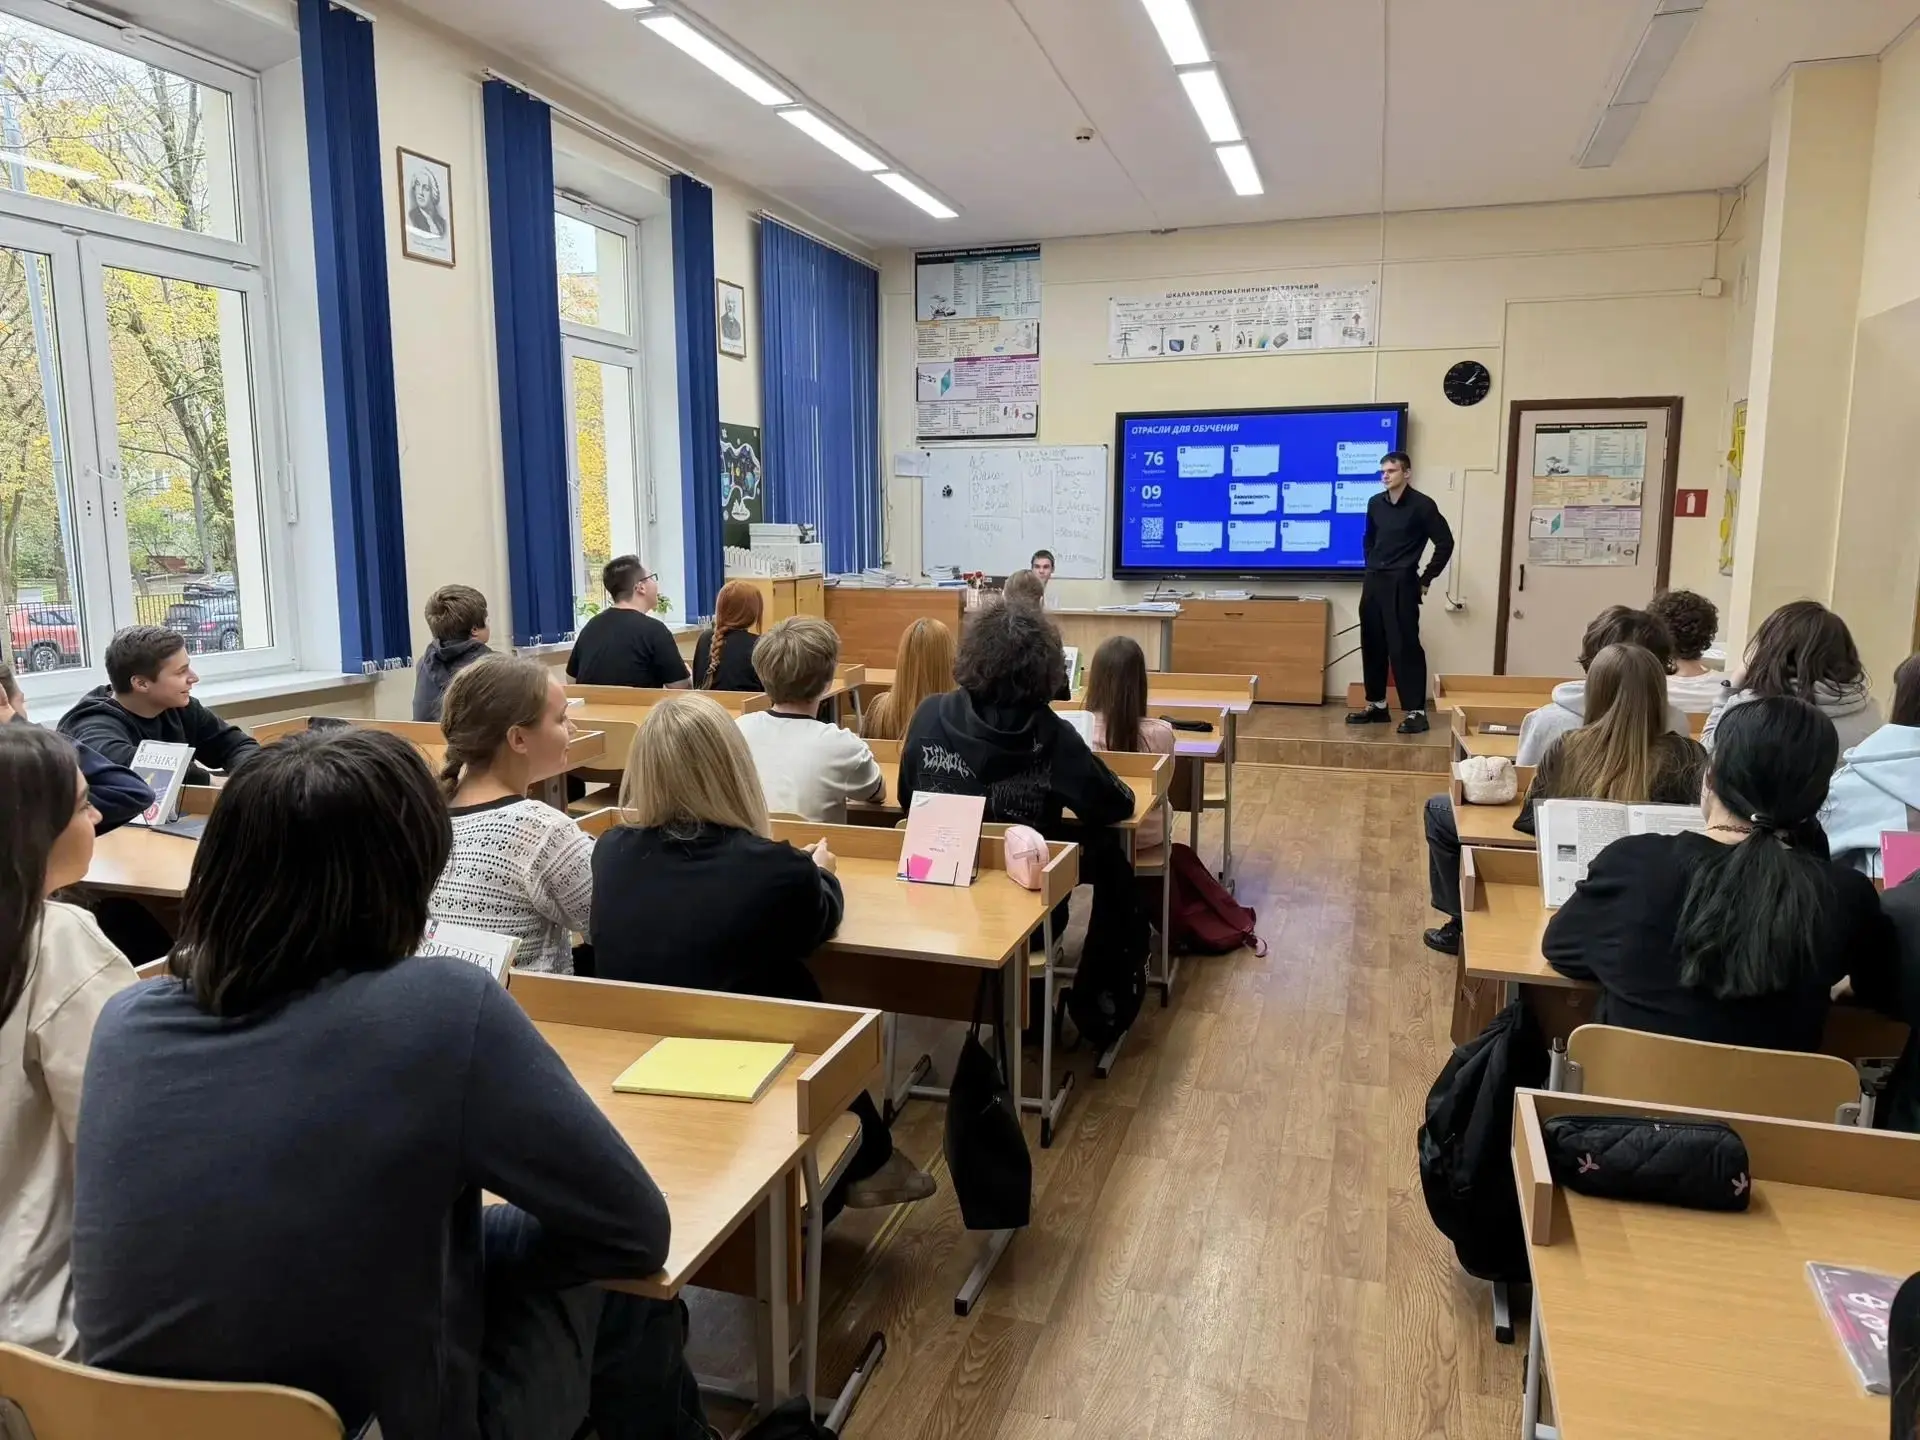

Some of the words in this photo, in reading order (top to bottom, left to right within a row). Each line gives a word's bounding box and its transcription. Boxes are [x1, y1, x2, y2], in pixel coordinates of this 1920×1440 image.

[1131, 425, 1171, 435] ОТРАСЛИ
[1171, 425, 1191, 435] ДЛЯ
[1192, 423, 1239, 433] ОБУЧЕНИЯ
[1143, 451, 1164, 466] 76
[1141, 485, 1162, 500] 09
[137, 754, 178, 767] ФИЗИКА
